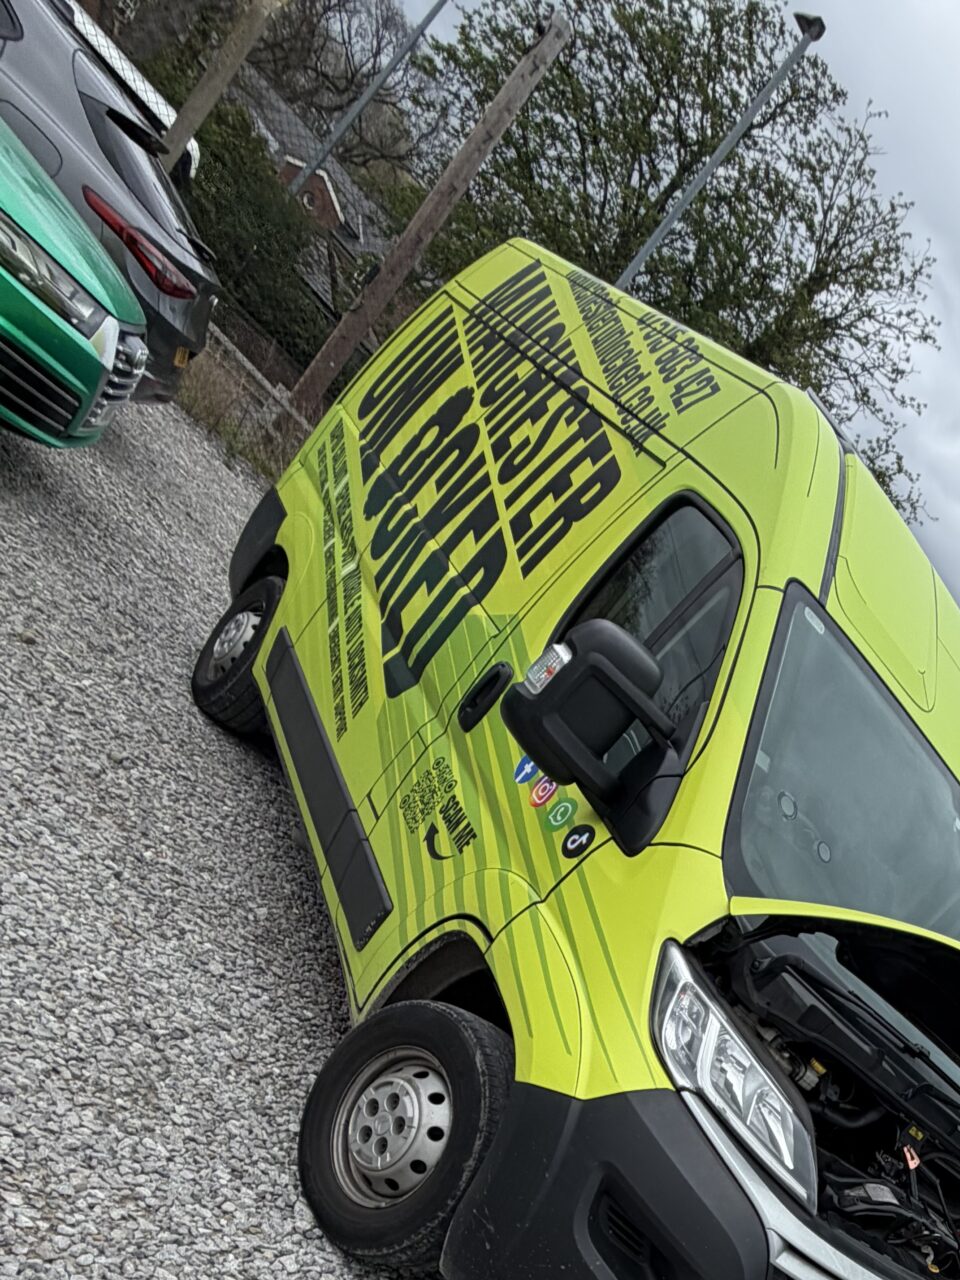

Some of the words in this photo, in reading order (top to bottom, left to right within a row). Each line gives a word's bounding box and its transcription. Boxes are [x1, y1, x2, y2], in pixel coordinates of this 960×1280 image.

[655, 337, 703, 384] 603
[670, 367, 721, 415] 427
[463, 258, 621, 580] MANCHESTER
[358, 305, 508, 698] UNLOCKED
[342, 563, 362, 616] MOBILE
[345, 603, 363, 646] AUTO
[347, 632, 369, 719] LOCKSMITH
[334, 694, 347, 743] SUPPORT
[439, 794, 467, 835] SCAN
[452, 821, 477, 855] ME
